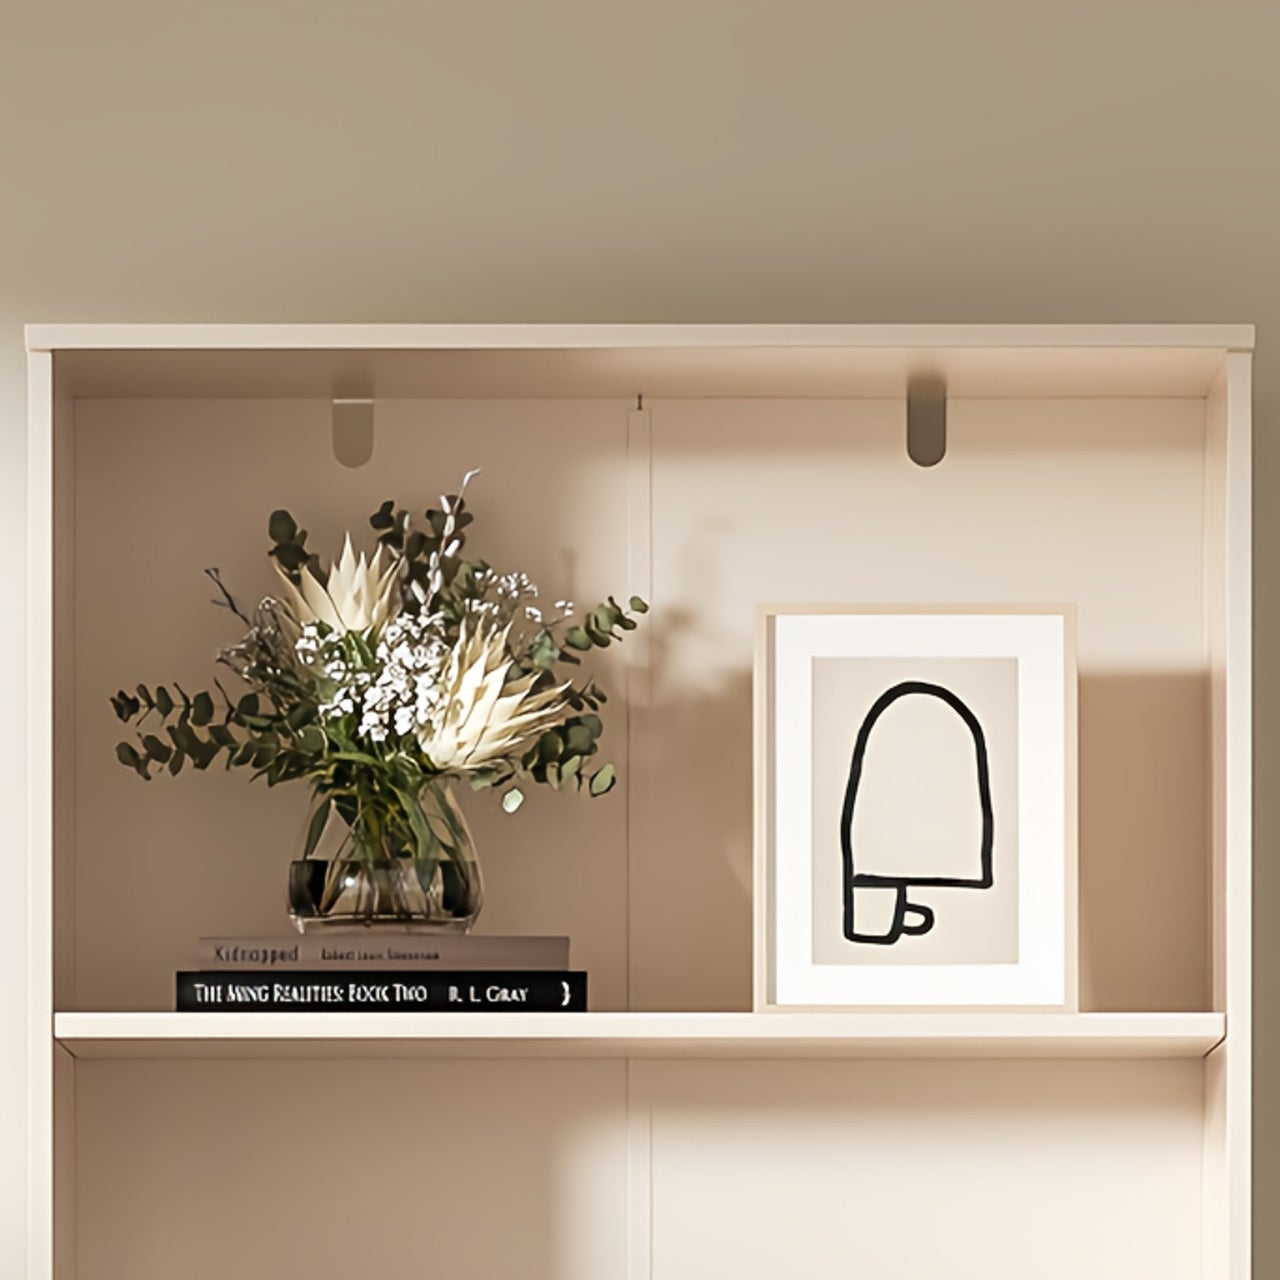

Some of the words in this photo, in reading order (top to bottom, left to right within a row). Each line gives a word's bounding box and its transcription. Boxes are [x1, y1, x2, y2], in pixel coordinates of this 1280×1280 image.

[194, 984, 223, 1003] THE
[392, 984, 428, 1003] TWO
[486, 985, 529, 1003] GRAY
